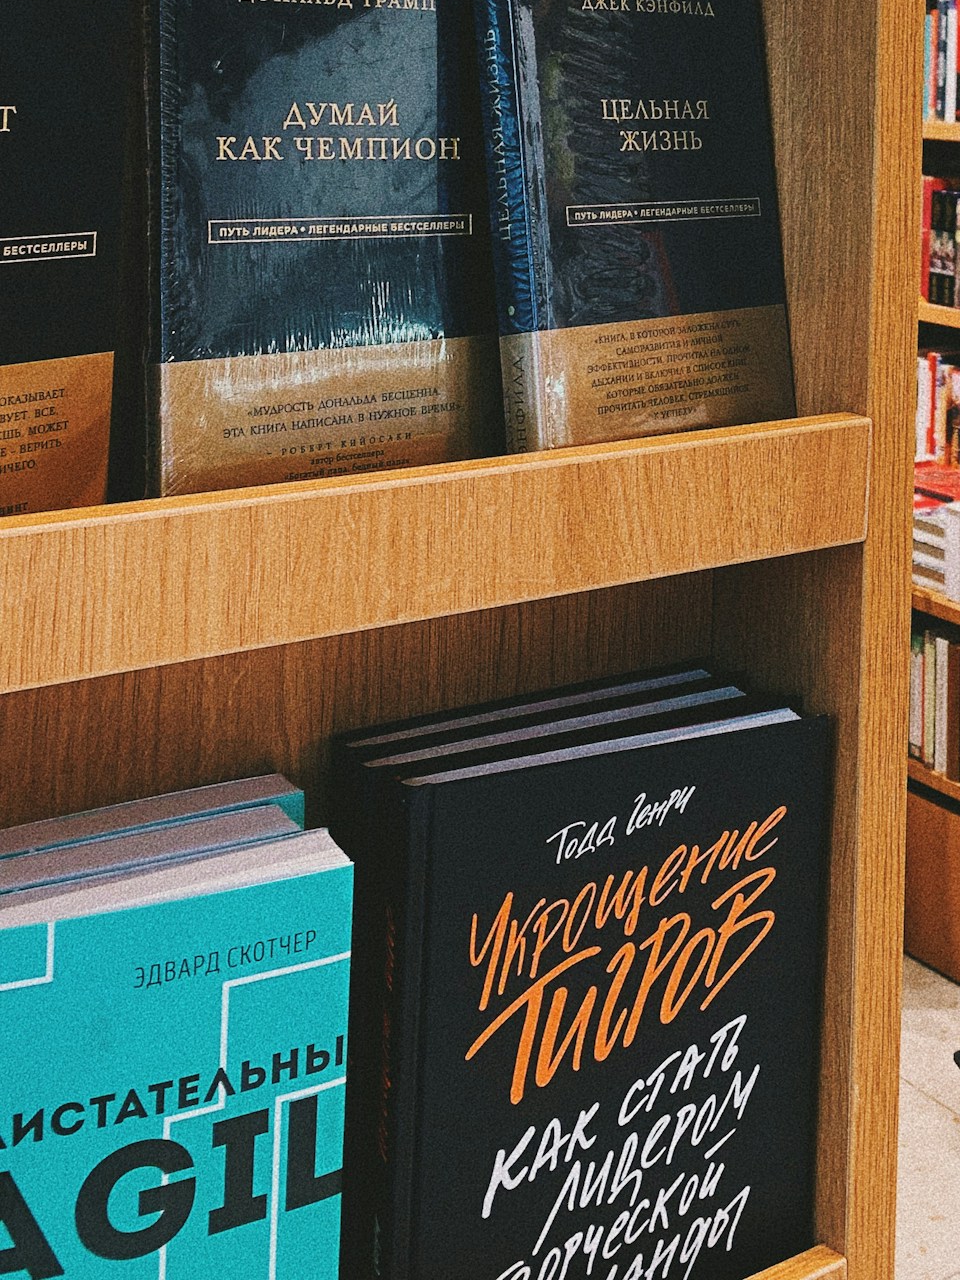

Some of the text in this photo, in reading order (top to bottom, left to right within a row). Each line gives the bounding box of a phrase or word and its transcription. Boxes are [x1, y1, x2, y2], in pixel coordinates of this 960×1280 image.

[283, 97, 400, 131] ДУМАЙ
[600, 98, 709, 125] ЦЕЛЬНАЯ
[216, 136, 461, 162] КАК ЧЕМПИОН
[619, 129, 703, 152] ЖИЗНЬ
[574, 204, 755, 221] ПУТЬ ЛИДЕРА ЛЕГЕНДАРНЫЕ БЕСТСЕЛЛЕРЫ
[219, 220, 465, 237] ПУТЬ ЛИДЕРА ЛЕГЕНДАРНЫЕ БЕСТСЕЛЛЕРЫ
[3, 240, 88, 257] БЕСТСЕЛЛЕРЫ
[630, 332, 636, 340] В
[637, 326, 675, 340] КОТОРОЙ
[616, 339, 681, 356] САМОРАЗВИТИЯ
[606, 386, 645, 400] КОТОРЫЕ
[648, 378, 704, 394] ОБЯЗАТЕЛЬНО
[318, 395, 377, 409] ДОНАЛЬДА
[597, 401, 646, 415] ПРОЧИТАТЬ
[28, 421, 70, 436] МОЖЕТ
[223, 428, 245, 439] ЭТА
[250, 422, 288, 437] КНИГА
[292, 415, 353, 432] НАПИСАНА
[358, 413, 365, 423] В
[369, 407, 417, 422] НУЖНОЕ
[281, 431, 413, 455] РОБЕРТ КИЙОСАКИ
[310, 448, 385, 467] автор бестселлера
[134, 929, 317, 989] ЭДВАРД СКОТЧЕР
[481, 1014, 747, 1218] КАК СТАТЬ
